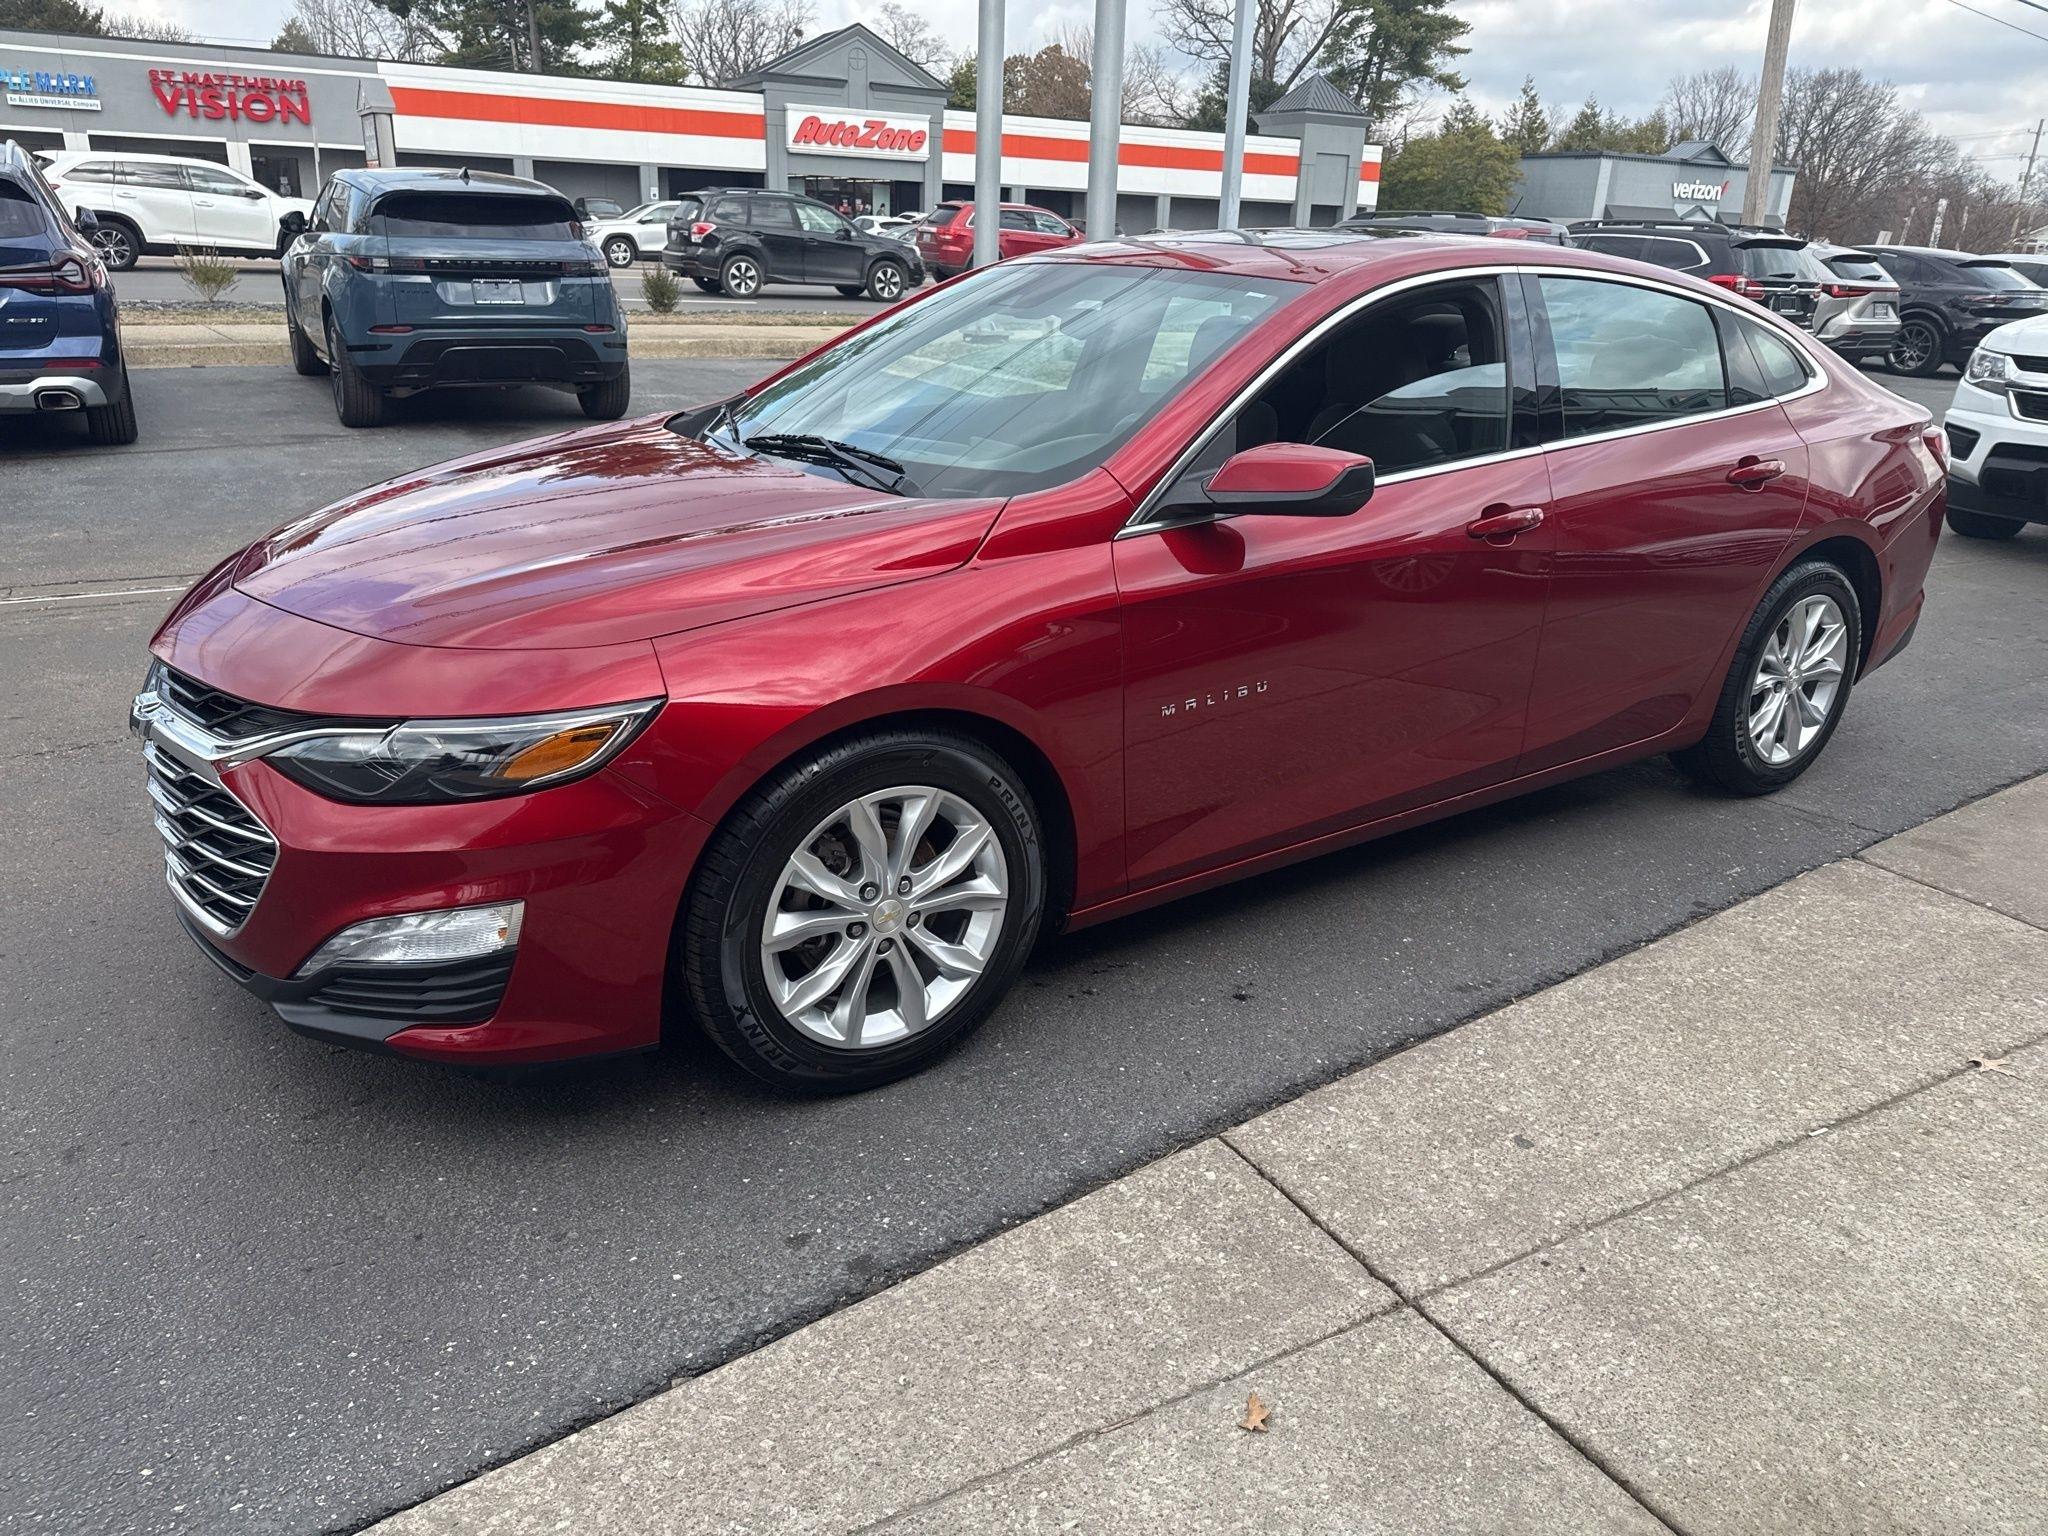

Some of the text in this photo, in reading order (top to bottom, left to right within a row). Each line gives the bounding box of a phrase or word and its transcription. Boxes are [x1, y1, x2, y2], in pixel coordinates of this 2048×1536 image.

[35, 71, 96, 95] MARK
[182, 72, 307, 95] MATTHEWS
[151, 86, 311, 125] VISION
[793, 115, 927, 151] AutoZone
[1673, 179, 1722, 201] verizon
[1161, 680, 1268, 717] MALIBU
[987, 775, 1038, 846] PRINX
